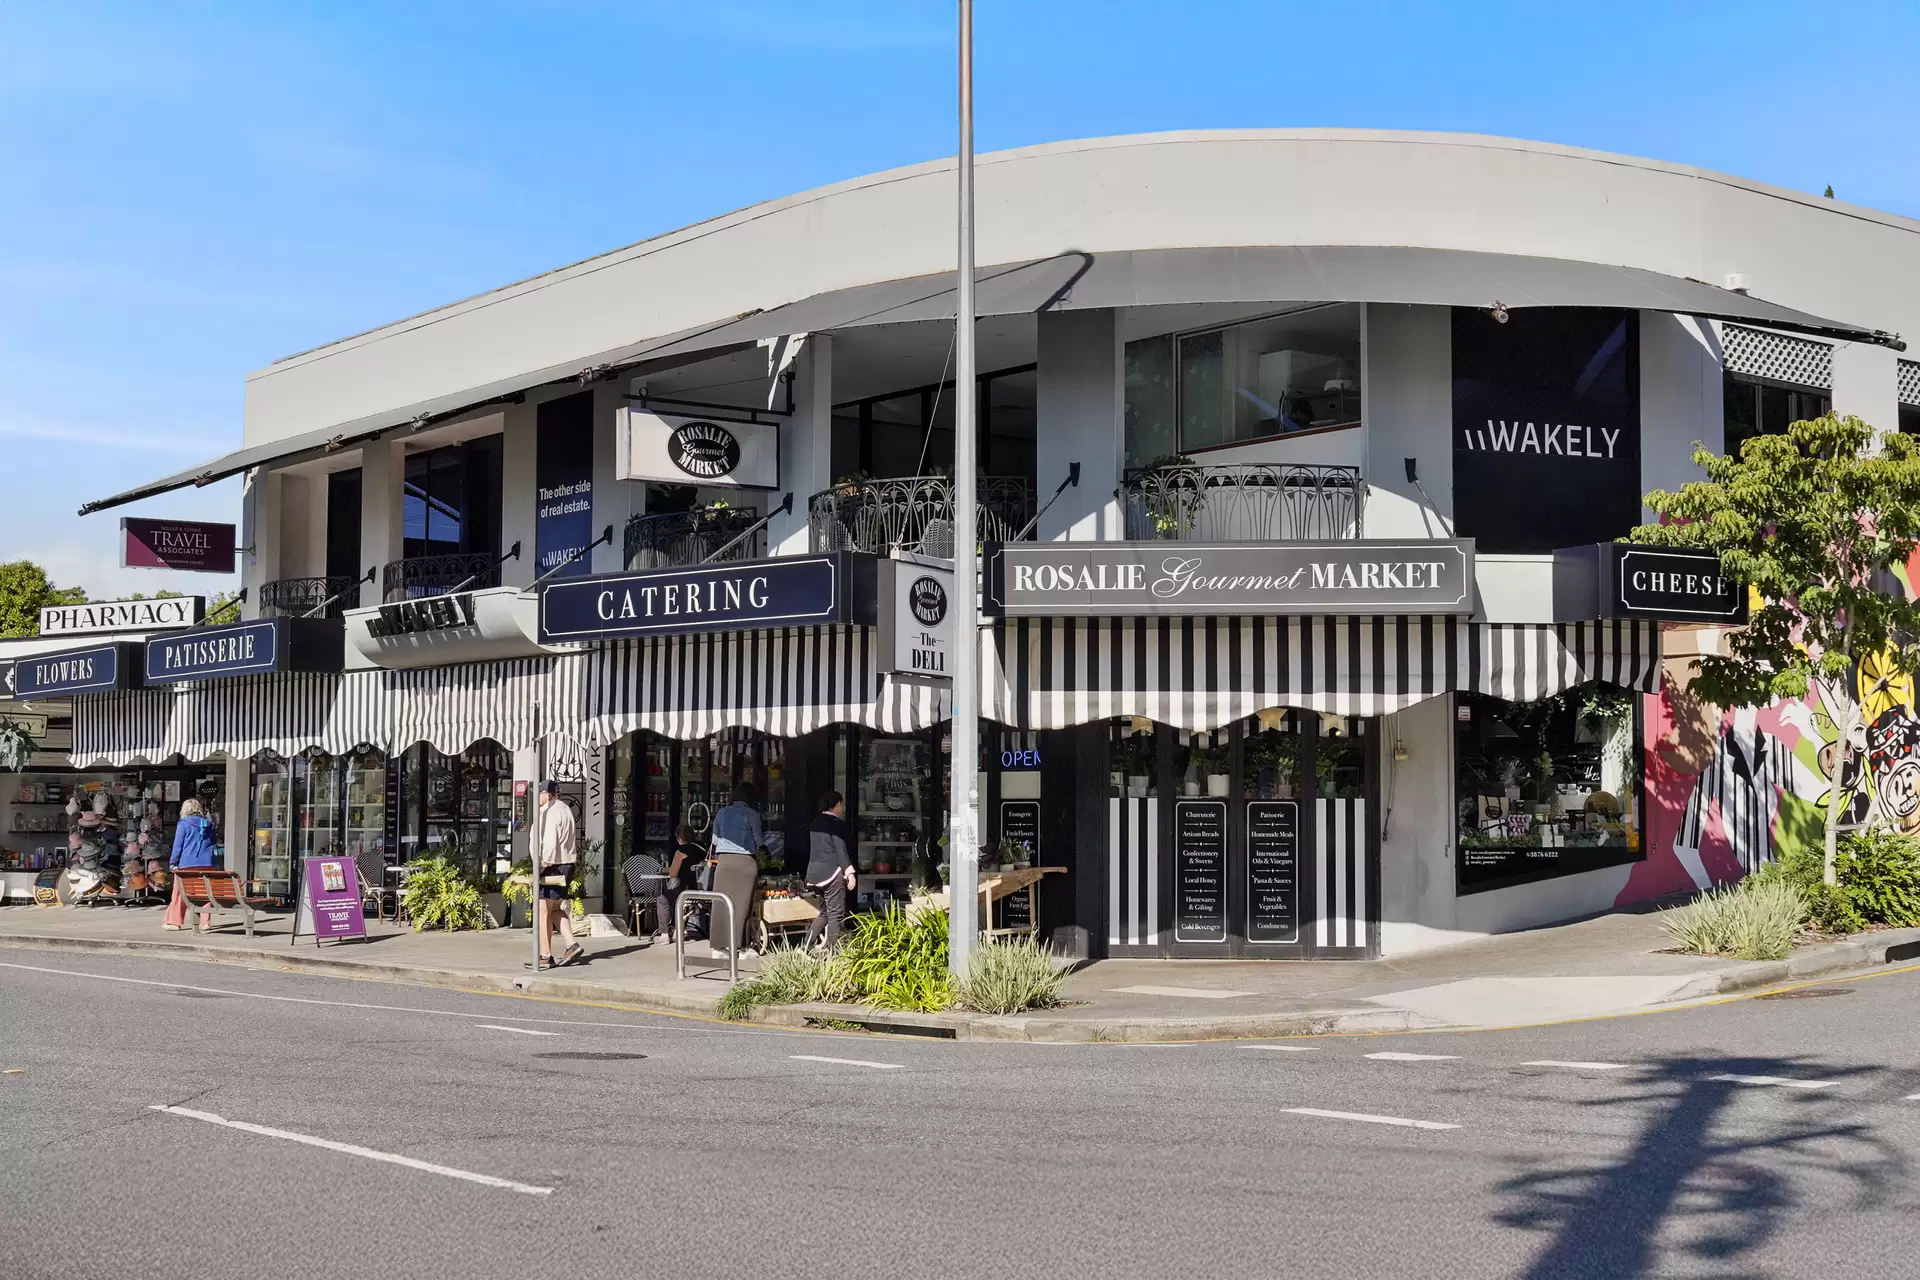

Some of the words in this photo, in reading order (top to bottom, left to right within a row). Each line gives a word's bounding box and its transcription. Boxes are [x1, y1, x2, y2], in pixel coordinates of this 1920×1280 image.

[677, 426, 732, 448] ROSALIE
[1488, 420, 1620, 458] WAKELY
[682, 442, 726, 456] Gourmet
[678, 456, 731, 475] MARKET
[539, 488, 553, 500] The
[554, 484, 574, 498] other
[575, 480, 591, 494] side
[541, 505, 549, 518] of
[549, 502, 563, 516] real
[564, 499, 591, 513] estate.
[151, 530, 212, 548] TRAVEL
[158, 546, 205, 556] ASSOCIATES
[1013, 564, 1147, 591] ROSALIE
[1151, 556, 1306, 598] Gourmet
[1309, 562, 1446, 589] MARKET
[1633, 570, 1729, 597] CHEESE
[597, 576, 769, 620] CATERING
[915, 581, 942, 599] ROSALIE
[44, 601, 190, 630] PHARMACY
[916, 602, 940, 621] MARKET
[919, 632, 936, 647] The
[165, 635, 255, 668] PATISSERIE
[912, 649, 944, 671] DELI
[36, 658, 93, 685] FLOWERS
[1001, 750, 1042, 767] OPEN
[1182, 850, 1219, 858] Confectionery
[1270, 858, 1293, 867] Vinegars
[1199, 877, 1217, 885] Honey
[327, 912, 351, 920] TRAVEL
[1194, 904, 1214, 912] Gifting
[1258, 903, 1288, 911] Vegetables
[1194, 923, 1221, 932] Beverages
